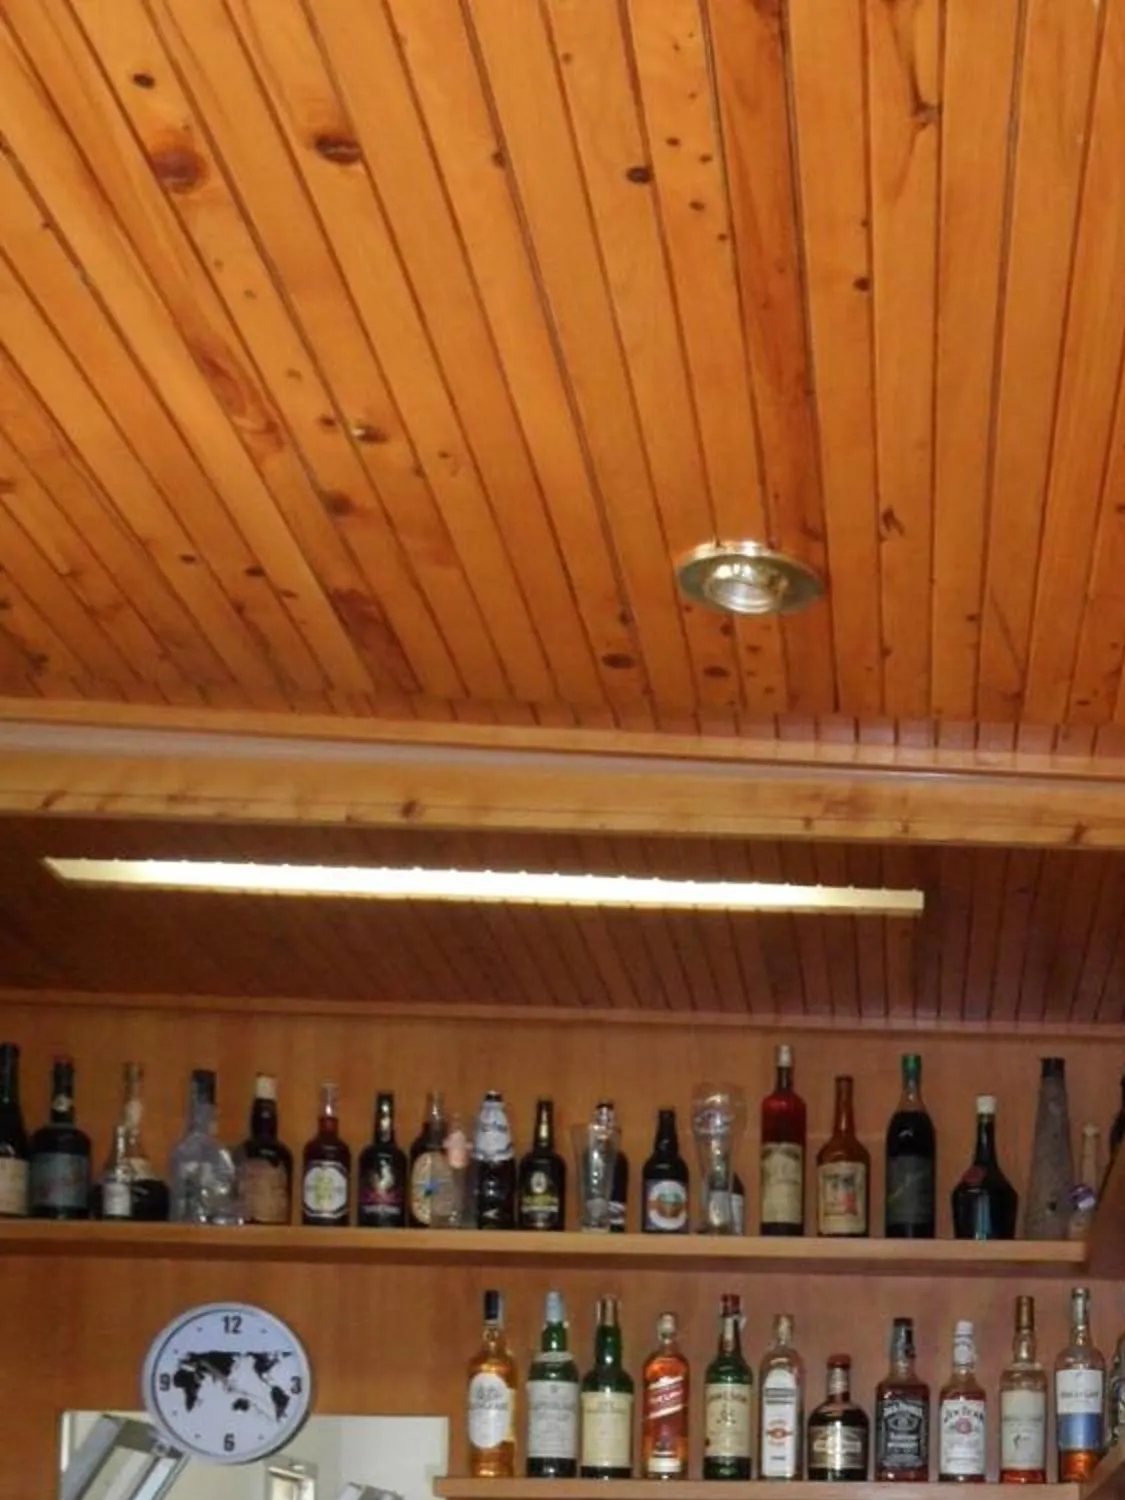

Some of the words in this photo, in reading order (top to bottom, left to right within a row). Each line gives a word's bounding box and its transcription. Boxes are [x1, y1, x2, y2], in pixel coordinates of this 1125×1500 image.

[222, 1315, 242, 1334] 12
[159, 1373, 171, 1391] 9
[290, 1376, 302, 1394] 3
[223, 1433, 235, 1451] 6
